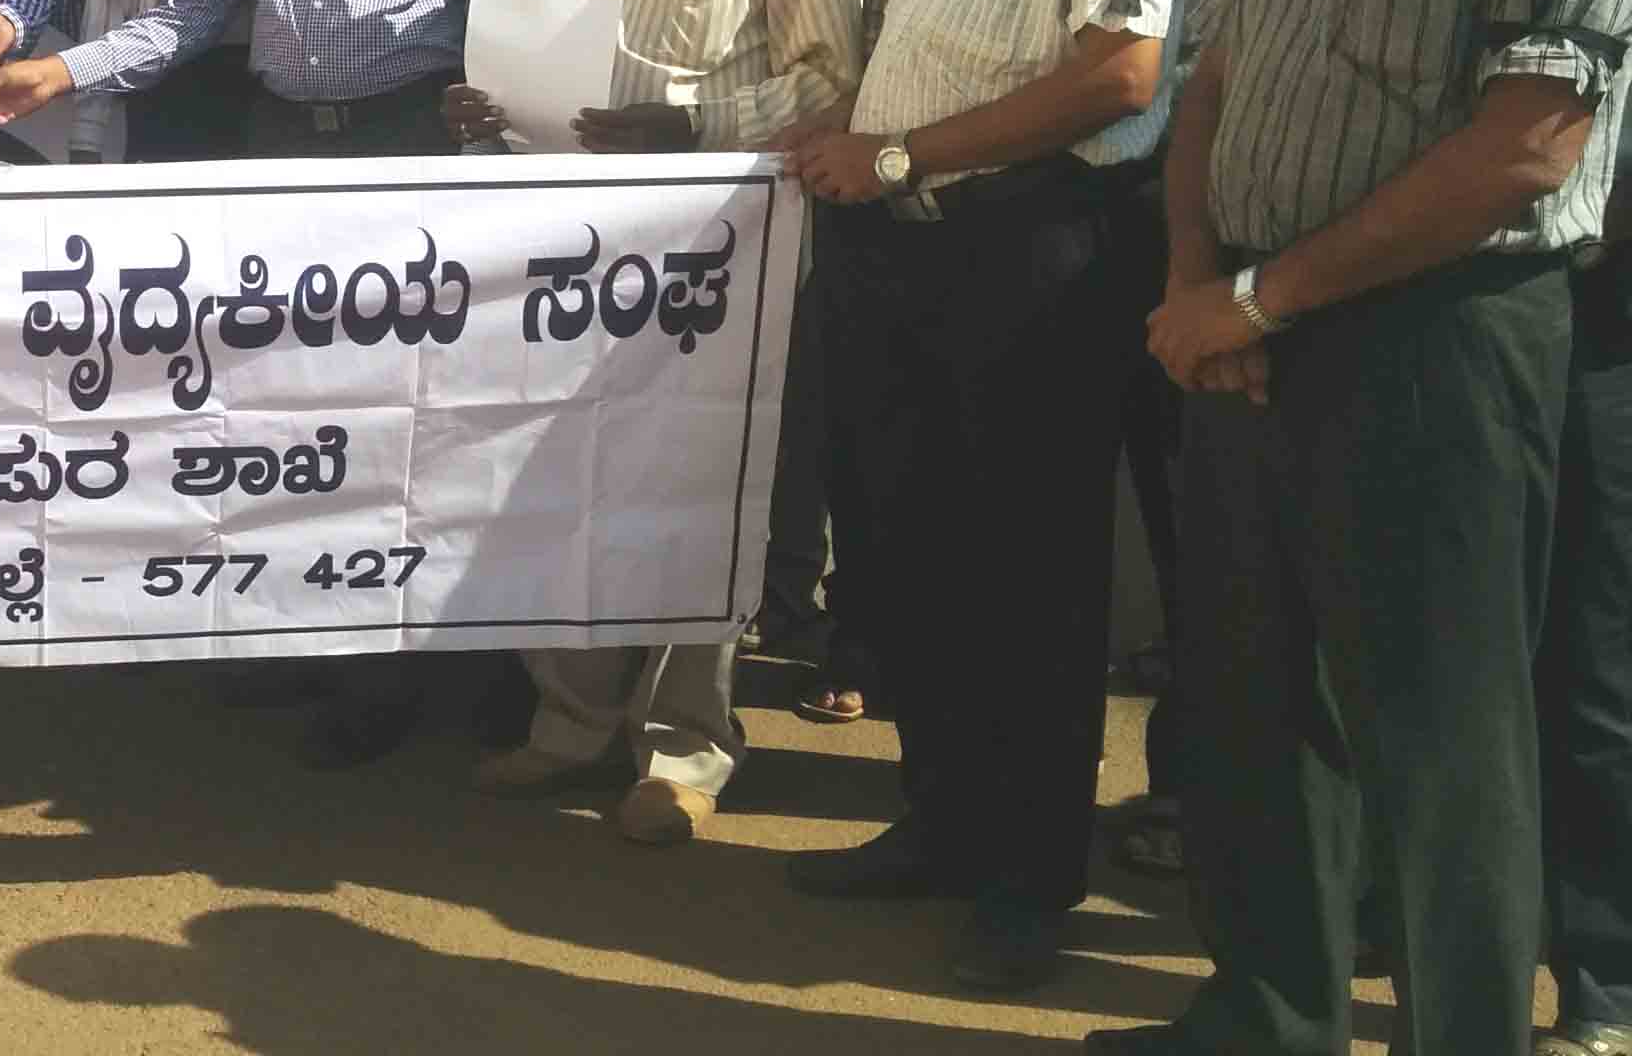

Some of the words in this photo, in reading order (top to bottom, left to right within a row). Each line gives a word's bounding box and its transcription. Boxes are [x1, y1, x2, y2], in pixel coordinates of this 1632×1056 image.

[20, 226, 472, 412] ವೈದ್ಯಕೀಯ
[522, 218, 737, 355] ಸಂಘ
[171, 424, 350, 497] ಶಾಖೆ
[142, 554, 269, 599] 577
[303, 547, 427, 591] 427
